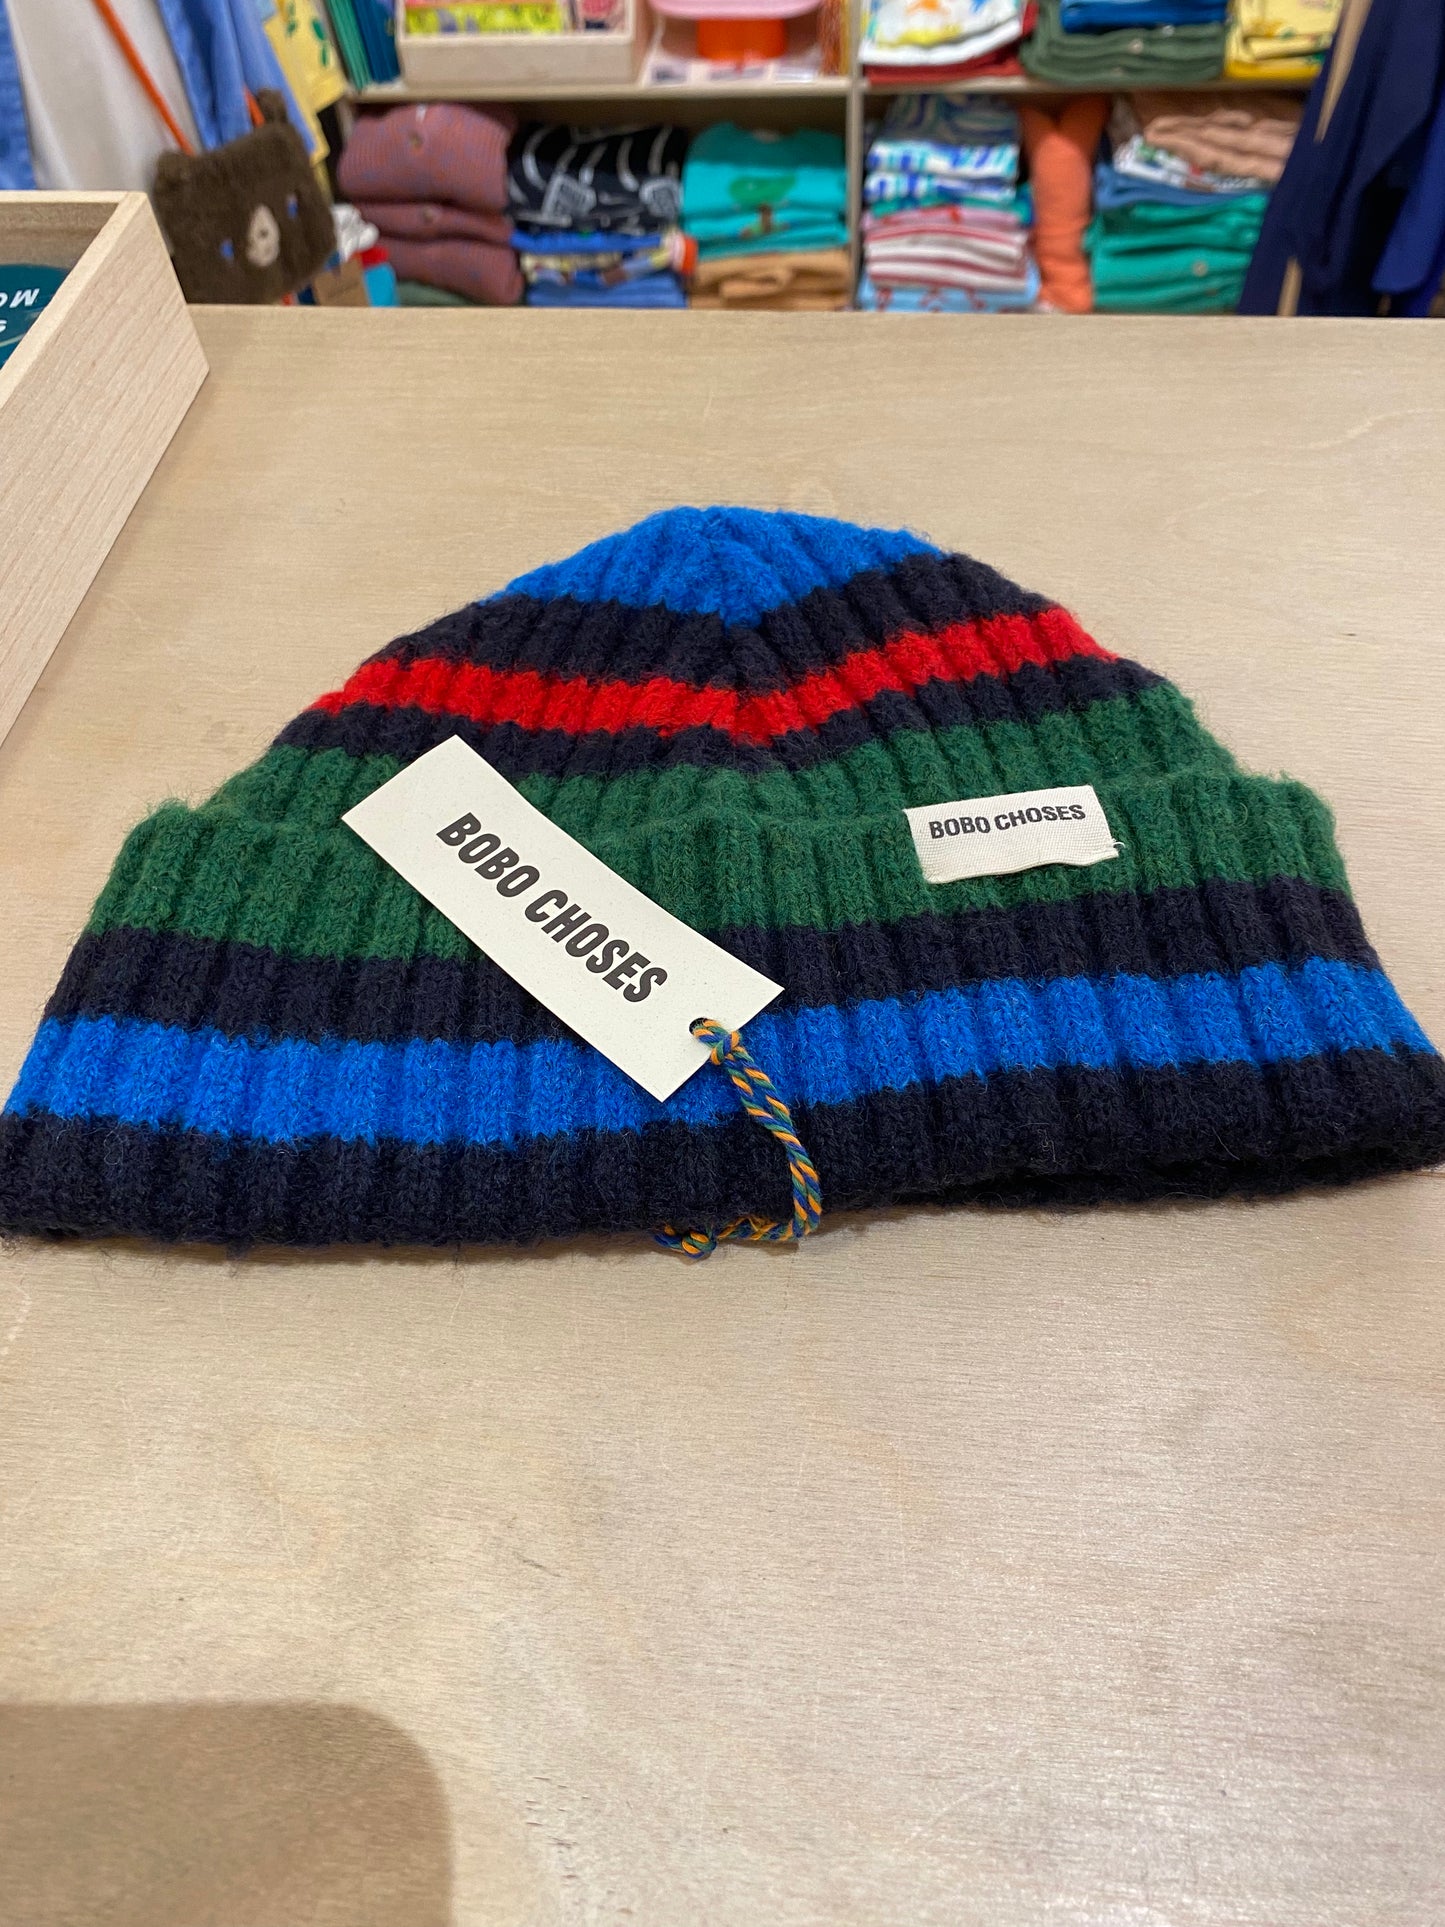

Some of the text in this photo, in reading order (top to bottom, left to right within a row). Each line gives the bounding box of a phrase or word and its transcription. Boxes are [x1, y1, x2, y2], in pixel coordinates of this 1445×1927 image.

[929, 804, 1086, 839] BOBO CHOSES
[436, 812, 668, 1003] BOBO CHOSES
